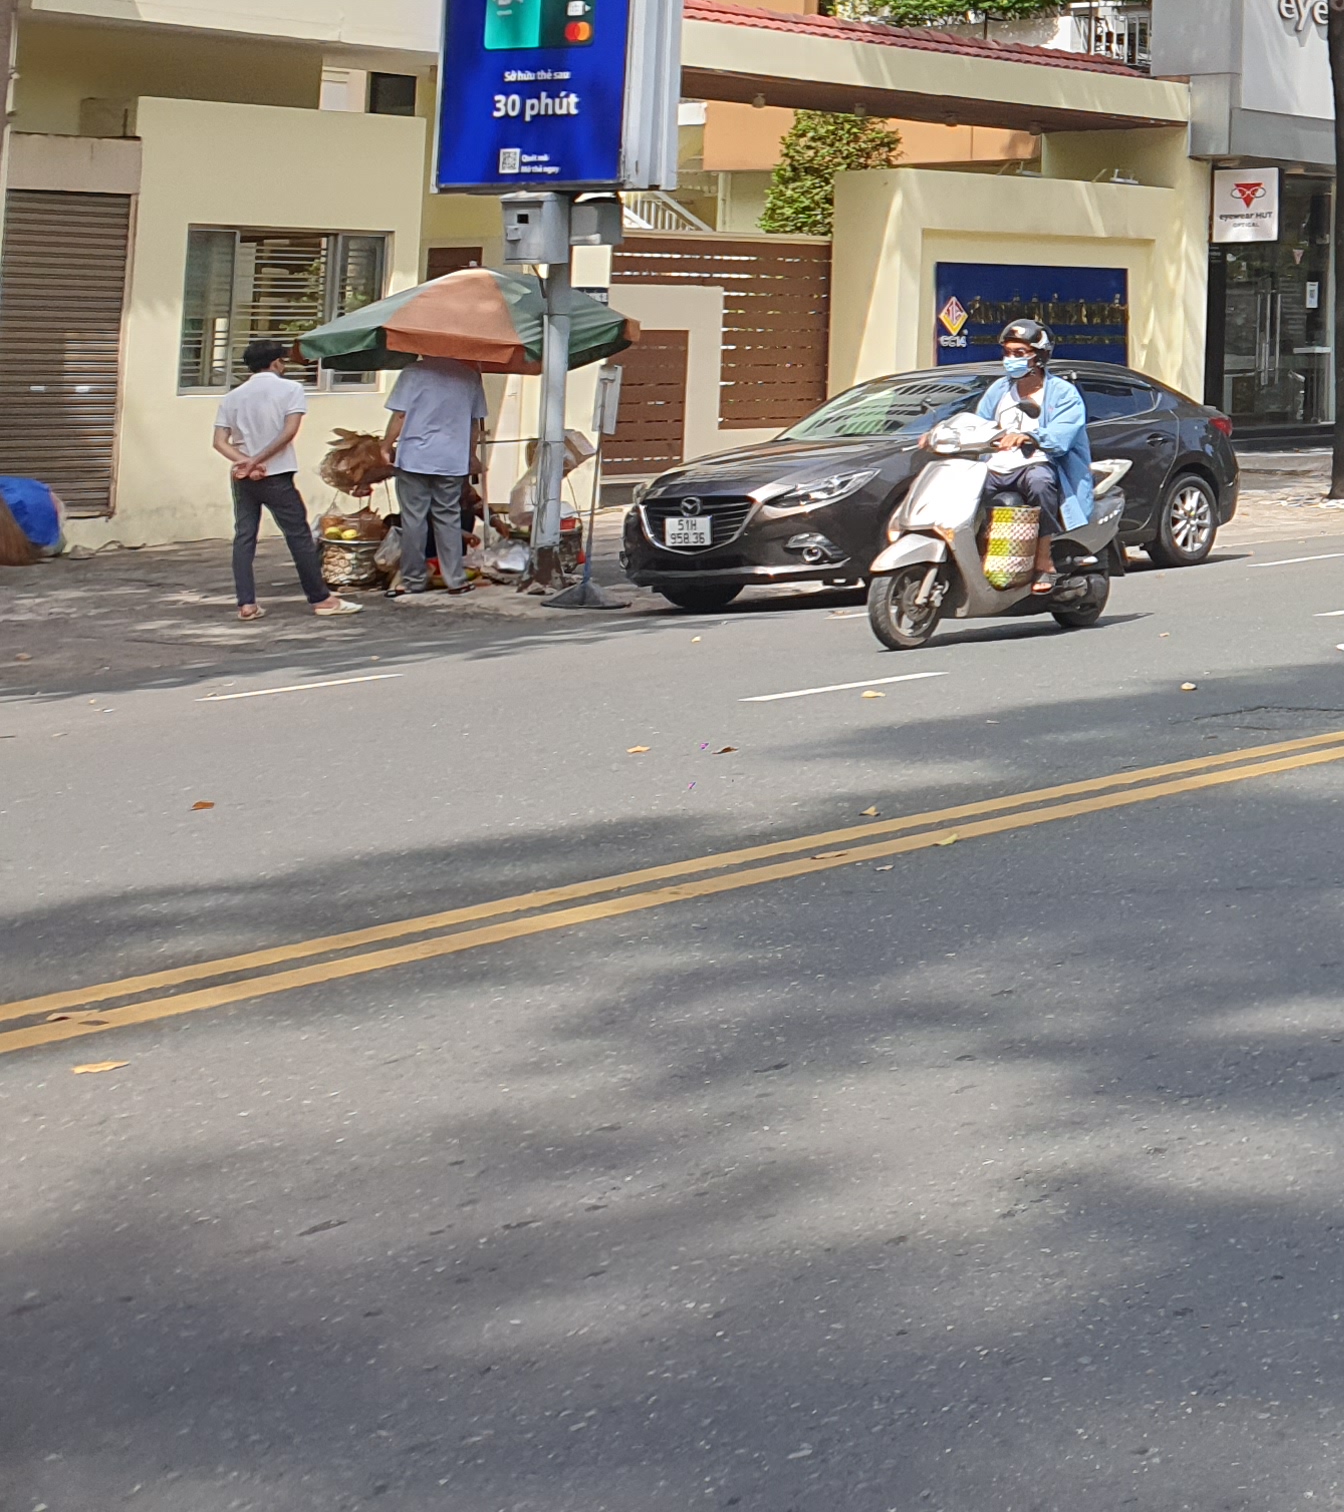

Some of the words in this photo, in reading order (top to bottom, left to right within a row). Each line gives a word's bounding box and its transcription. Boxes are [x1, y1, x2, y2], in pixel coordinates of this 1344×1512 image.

[493, 94, 520, 117] 30
[525, 91, 580, 122] phút
[1219, 213, 1255, 222] eyewear
[1255, 211, 1273, 220] HUT
[677, 519, 697, 531] 51H
[670, 531, 706, 545] 958.36
